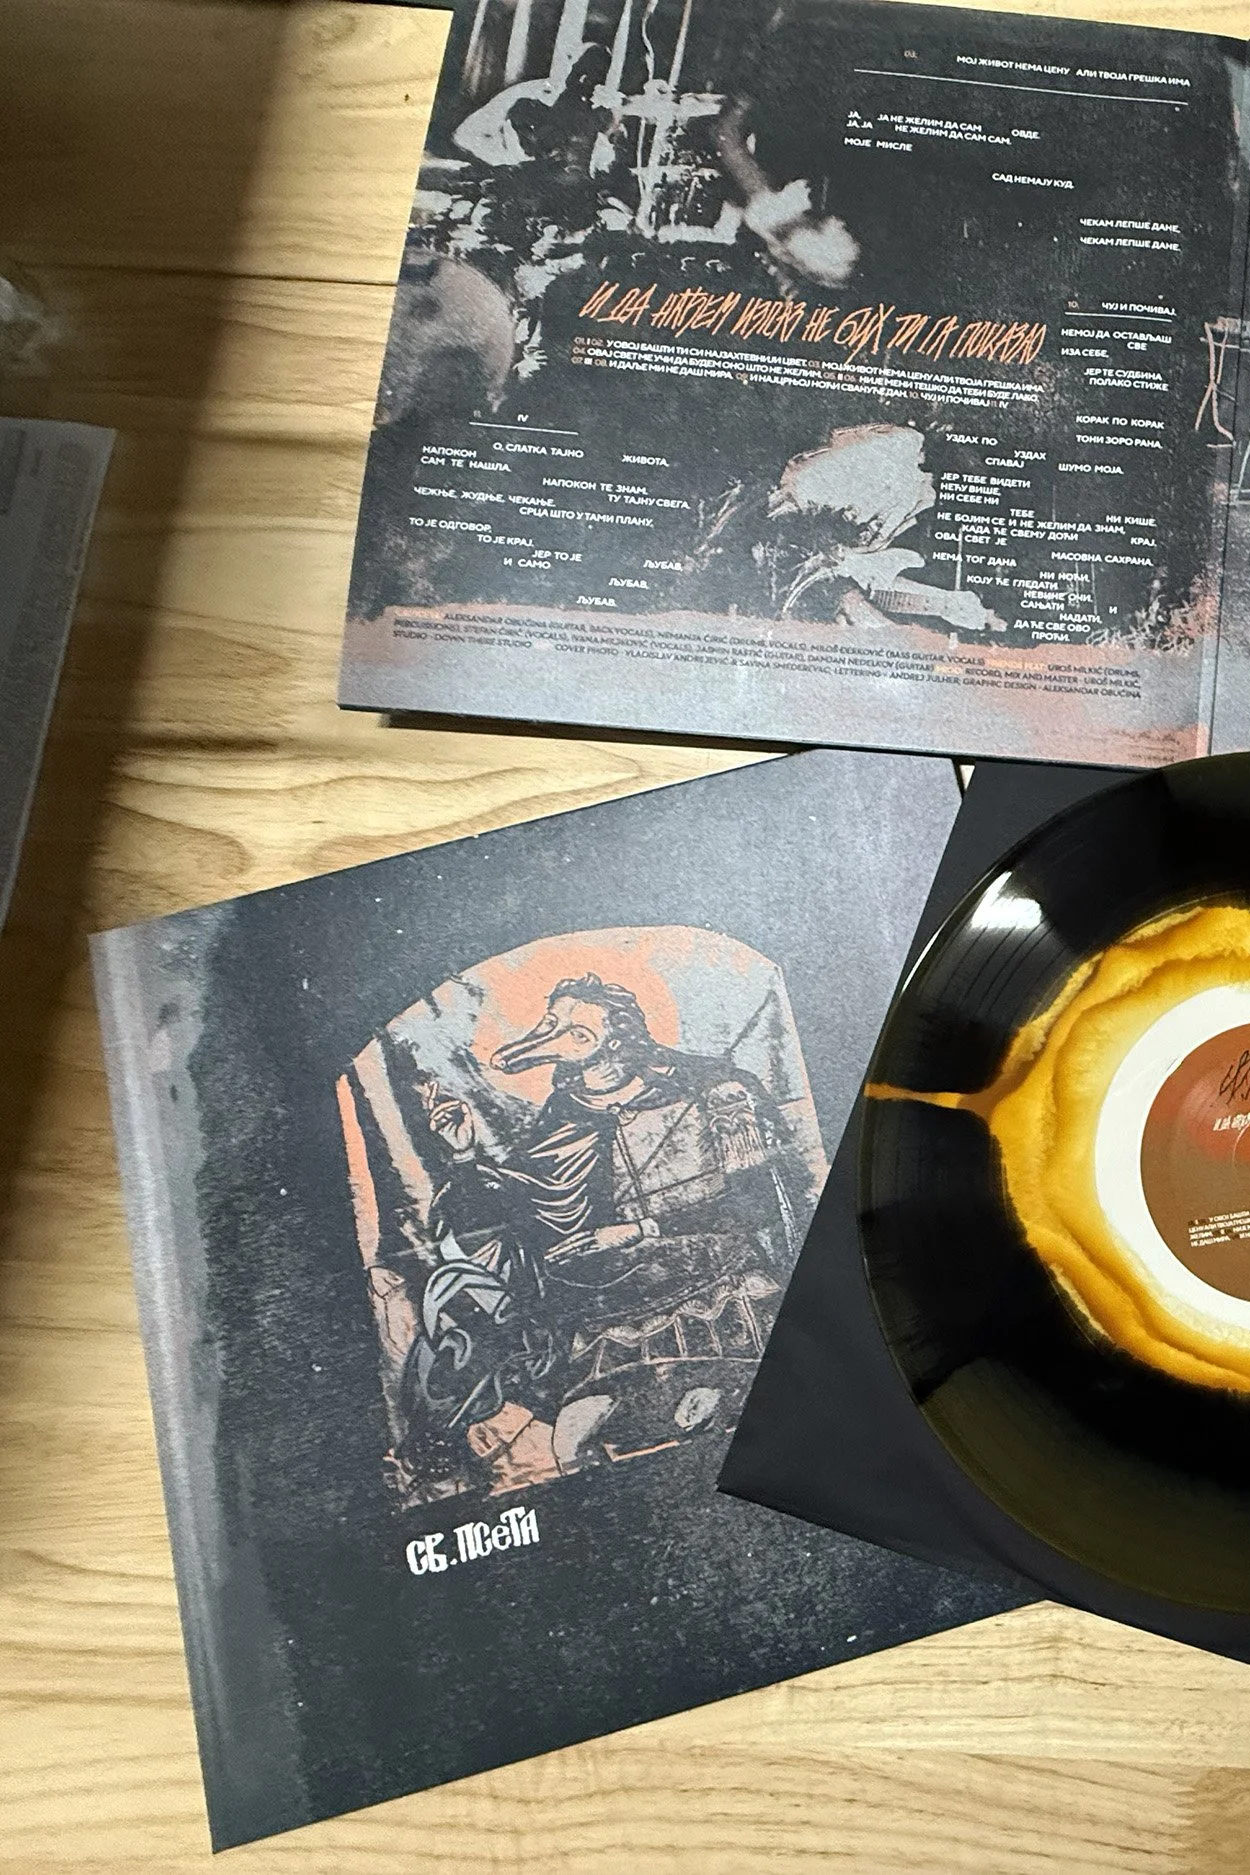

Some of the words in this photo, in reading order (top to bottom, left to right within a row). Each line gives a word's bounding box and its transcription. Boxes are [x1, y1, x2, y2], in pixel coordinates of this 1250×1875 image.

[957, 56, 977, 64] МОЈ
[978, 58, 1014, 68] ЖИВОТ
[1015, 62, 1042, 72] НЕМА
[1044, 65, 1070, 75] ЦЕНУ
[1076, 69, 1097, 77] АЛИ
[1099, 71, 1127, 80] ТВОЈА
[1128, 74, 1167, 84] ГРЕШКА
[1168, 78, 1190, 86] ИМА
[844, 138, 871, 147] МОЈЕ
[876, 141, 912, 151] МИСЛЕ
[992, 173, 1013, 183] САД
[1014, 176, 1053, 186] НЕМАЈУ
[1080, 219, 1114, 227] ЧЕКАМ
[1115, 220, 1150, 229] ЛЕПШЕ
[1080, 237, 1114, 245] ЧЕКАМ
[1115, 239, 1151, 248] ЛЕПШЕ
[1102, 302, 1118, 310] ЧУЈ
[1061, 329, 1096, 338] НЕМОЈ
[1095, 330, 1110, 339] ДА
[1113, 331, 1172, 344] ОСТАВЉАШ
[1061, 348, 1081, 356] ИЗА
[1127, 342, 1147, 350] СВЕ
[1103, 369, 1114, 377] ТЕ
[1115, 370, 1162, 381] СУДБИНА
[1089, 378, 1132, 387] ПОЛАКО
[1133, 381, 1168, 391] СТИЖЕ
[1076, 416, 1109, 424] КОРАК
[1112, 417, 1128, 425] ПО
[1131, 419, 1164, 429] КОРАК
[946, 434, 978, 444] УЗДАХ
[981, 437, 998, 446] ПО
[1076, 435, 1104, 443] ТОНИ
[1105, 436, 1133, 446] ЗОРО
[423, 446, 477, 458] НАПОКОН
[505, 443, 547, 455] СЛАТКА
[551, 448, 584, 458] ТАЈНО
[1014, 450, 1046, 460] УЗДАХ
[421, 456, 445, 465] САМ
[451, 459, 464, 467] ТЕ
[985, 457, 1024, 468] СПАВАЈ
[1059, 464, 1091, 472] ШУМО
[543, 478, 596, 490] НАПОКОН
[600, 483, 613, 492] ТЕ
[941, 473, 960, 482] ЈЕР
[962, 474, 987, 484] ТЕБЕ
[990, 477, 1030, 488] ВИДЕТИ
[608, 494, 621, 502] ТУ
[624, 495, 655, 506] ТАЈНУ
[1051, 552, 1102, 562] МАСОВНА
